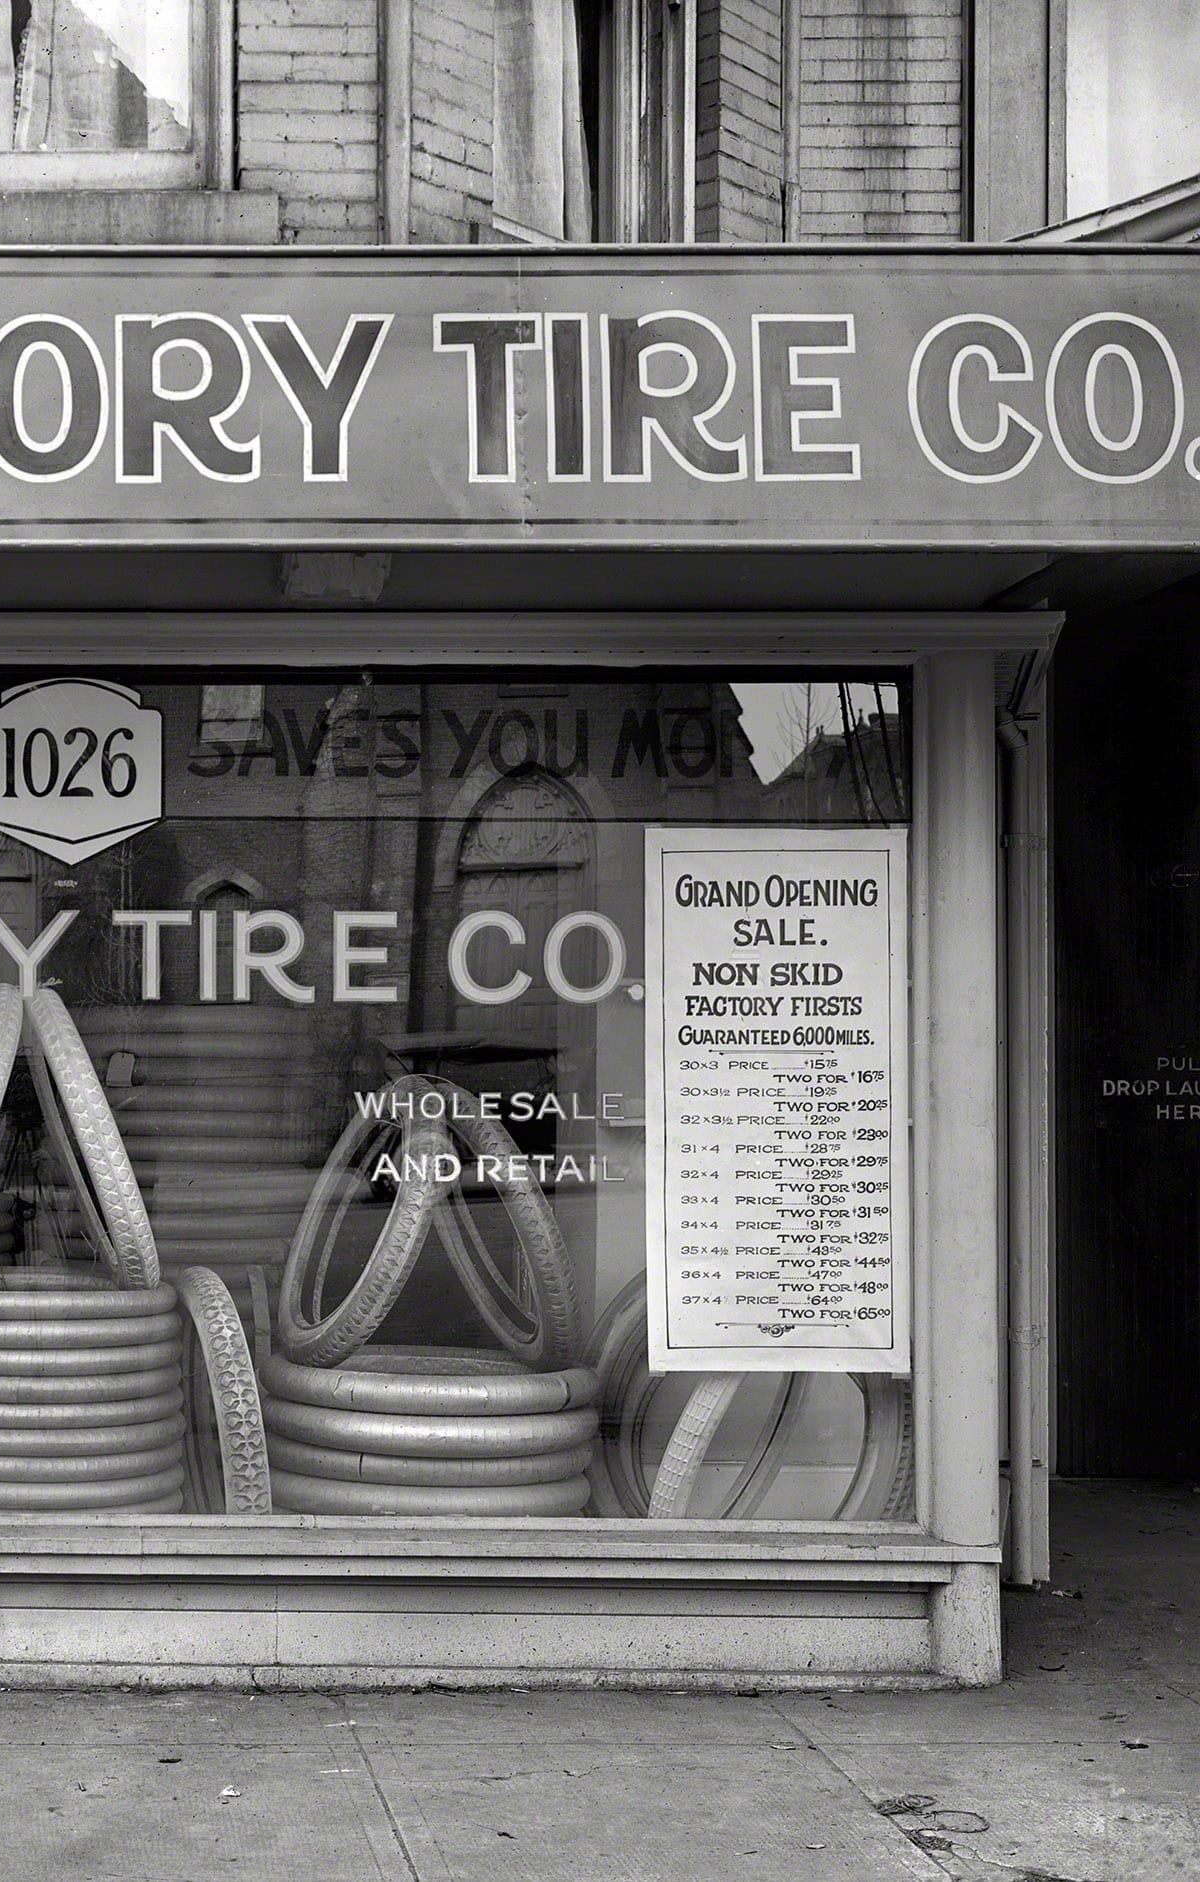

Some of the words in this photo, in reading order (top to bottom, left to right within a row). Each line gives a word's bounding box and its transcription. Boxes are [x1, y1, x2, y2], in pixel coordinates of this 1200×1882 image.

[432, 309, 861, 483] TIRE
[441, 708, 589, 779] YOU
[1, 726, 138, 798] 1026
[675, 874, 760, 908] GRAND
[765, 874, 878, 908] OPENING
[733, 918, 828, 947] SALE.
[111, 909, 398, 1003] TIRE
[447, 910, 646, 1005] CO.
[692, 963, 760, 986] NON
[770, 963, 843, 987] SKID
[685, 995, 784, 1017] FACTORY
[791, 996, 863, 1017] FIRSTS
[678, 1025, 791, 1046] GUARANTEED
[836, 1029, 875, 1046] MILES.
[728, 1062, 769, 1070] PRICE
[773, 1074, 812, 1083] TWO
[817, 1075, 848, 1083] FOR
[1102, 1079, 1160, 1096] DROP
[737, 1088, 785, 1097] PRICE
[353, 1091, 626, 1122] WHOLESALE
[773, 1102, 813, 1112] TWO
[817, 1102, 850, 1112] FOR
[737, 1116, 785, 1125] PRICE
[774, 1131, 812, 1140] TWO
[817, 1131, 847, 1140] FOR
[735, 1145, 783, 1154] PRICE
[775, 1158, 815, 1167] TWO
[819, 1159, 849, 1167] FOR
[370, 1152, 462, 1183] AND
[476, 1153, 625, 1183] RETAIL
[735, 1171, 783, 1179] PRICE
[775, 1183, 815, 1193] TWO
[819, 1183, 850, 1193] FOR
[735, 1196, 783, 1205] PRICE
[777, 1209, 815, 1218] TWO
[819, 1210, 850, 1218] FOR
[736, 1221, 782, 1230] PRICE
[777, 1235, 816, 1244] TWO
[819, 1235, 852, 1244] FOR
[736, 1247, 780, 1255] PRICE
[777, 1259, 816, 1268] TWO
[820, 1260, 850, 1268] FOR
[736, 1271, 780, 1280] PRICE
[778, 1284, 814, 1292] TWO
[819, 1284, 852, 1292] FOR
[736, 1296, 779, 1304] PRICE
[778, 1309, 815, 1319] TWO
[820, 1309, 852, 1319] FOR
